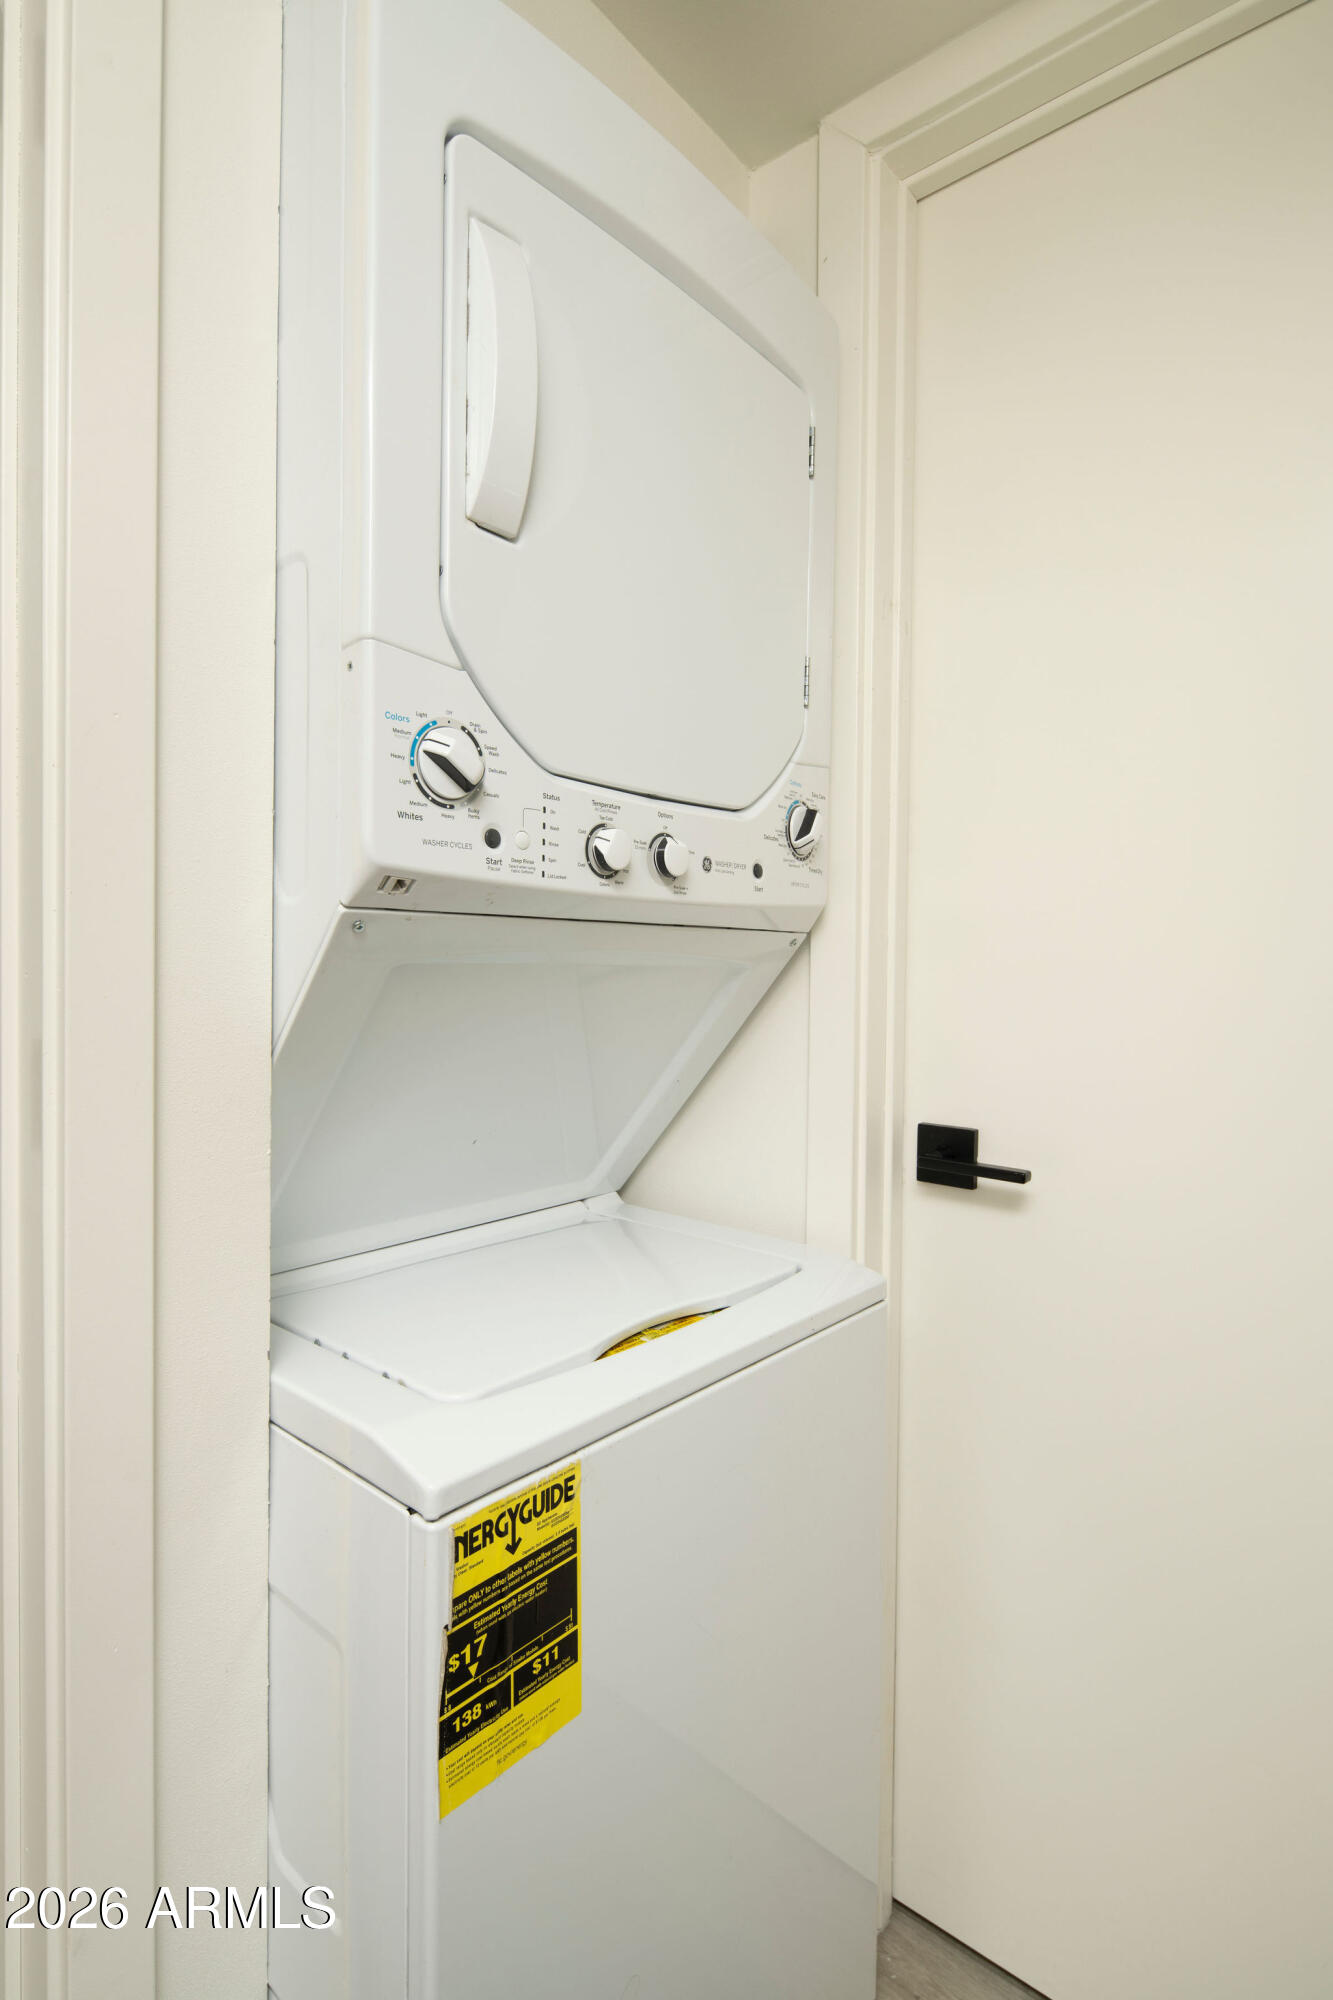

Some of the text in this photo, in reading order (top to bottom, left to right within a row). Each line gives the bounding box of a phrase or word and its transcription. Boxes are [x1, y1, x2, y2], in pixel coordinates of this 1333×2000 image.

[384, 711, 411, 723] Colors
[392, 727, 412, 736] Medium
[542, 792, 561, 801] Status
[409, 800, 429, 808] Medium
[592, 800, 621, 810] Temperature
[397, 811, 424, 822] Whites
[657, 811, 674, 820] Options
[422, 838, 473, 850] WASHER CYCLES
[485, 857, 503, 866] Start
[510, 857, 523, 865] Deep
[468, 1587, 484, 1603] ONLY
[485, 1583, 491, 1593] to
[491, 1575, 506, 1589] other
[507, 1565, 522, 1580] labels
[523, 1558, 534, 1570] with
[535, 1549, 550, 1565] yellow
[551, 1535, 573, 1553] numbers.
[473, 1606, 500, 1629] Estimated
[501, 1596, 516, 1614] Yearly
[517, 1585, 535, 1603] Energy
[535, 1577, 547, 1590] Cost
[448, 1633, 487, 1673] $17
[532, 1645, 559, 1675] $11
[452, 1703, 482, 1733] 138
[445, 1735, 466, 1753] Estimated
[467, 1725, 479, 1739] Yearly
